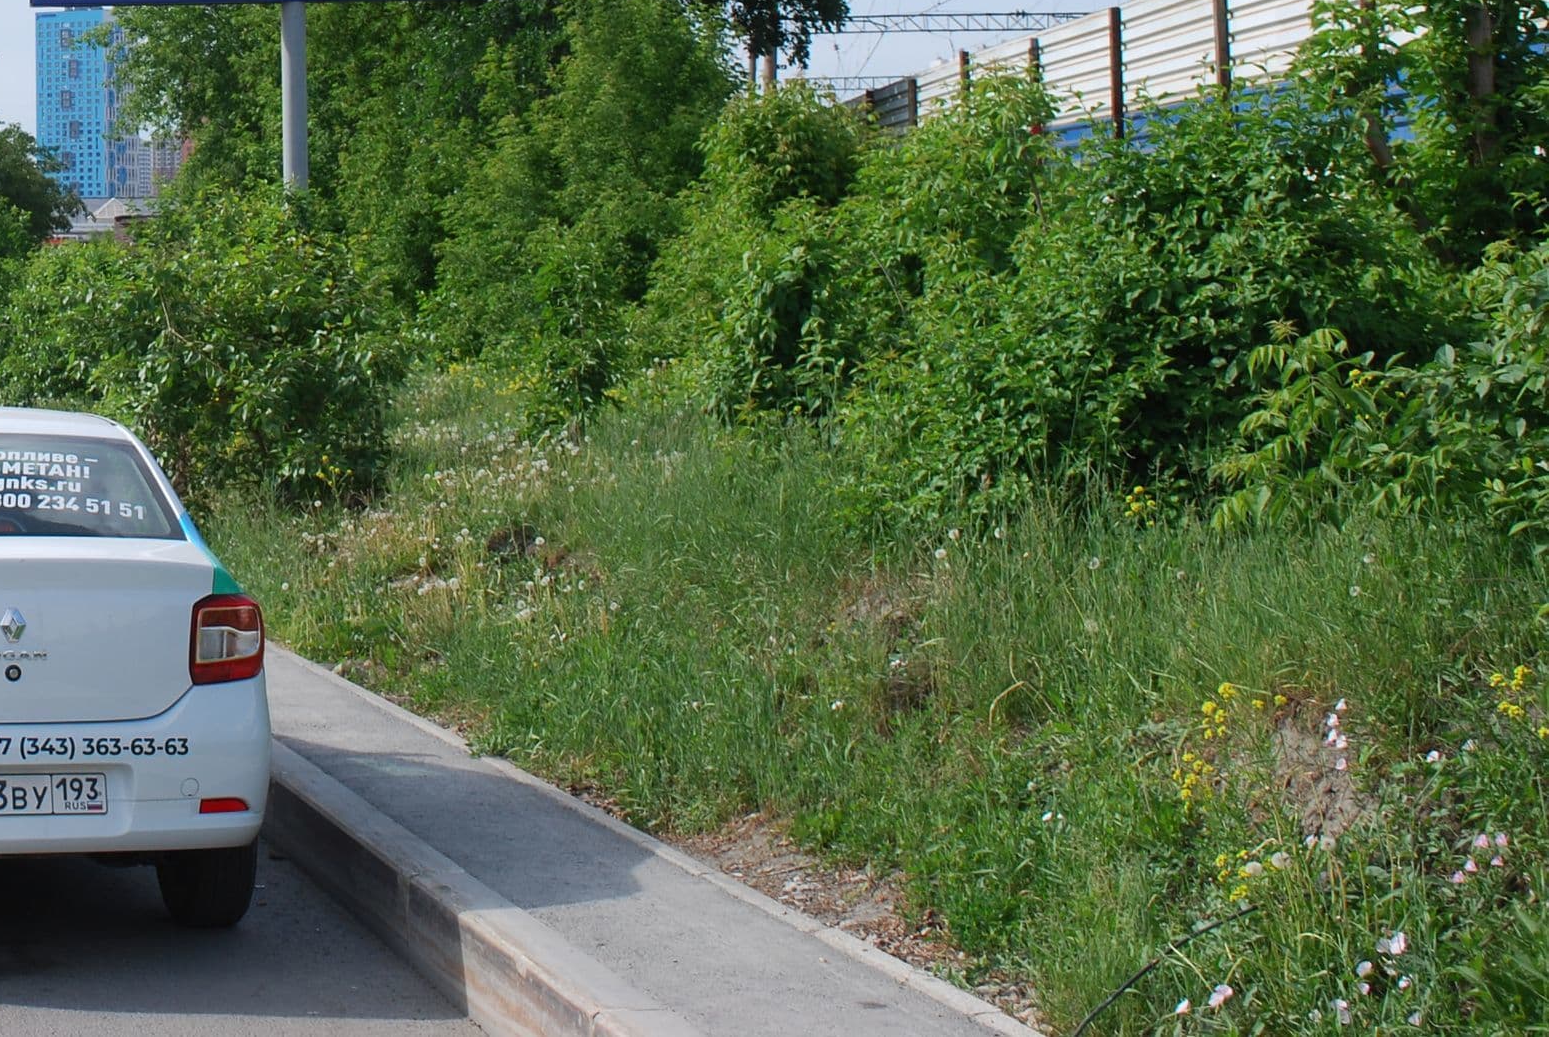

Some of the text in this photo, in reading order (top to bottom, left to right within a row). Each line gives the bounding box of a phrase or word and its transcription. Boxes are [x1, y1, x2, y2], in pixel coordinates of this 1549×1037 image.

[1, 462, 90, 479] МЕТАН!
[37, 494, 80, 511] 234
[86, 498, 111, 515] 51
[119, 501, 146, 520] 51
[19, 737, 76, 759] (343)
[82, 737, 189, 755] 363-63-63
[55, 777, 99, 801] 193
[64, 801, 86, 810] RUS
